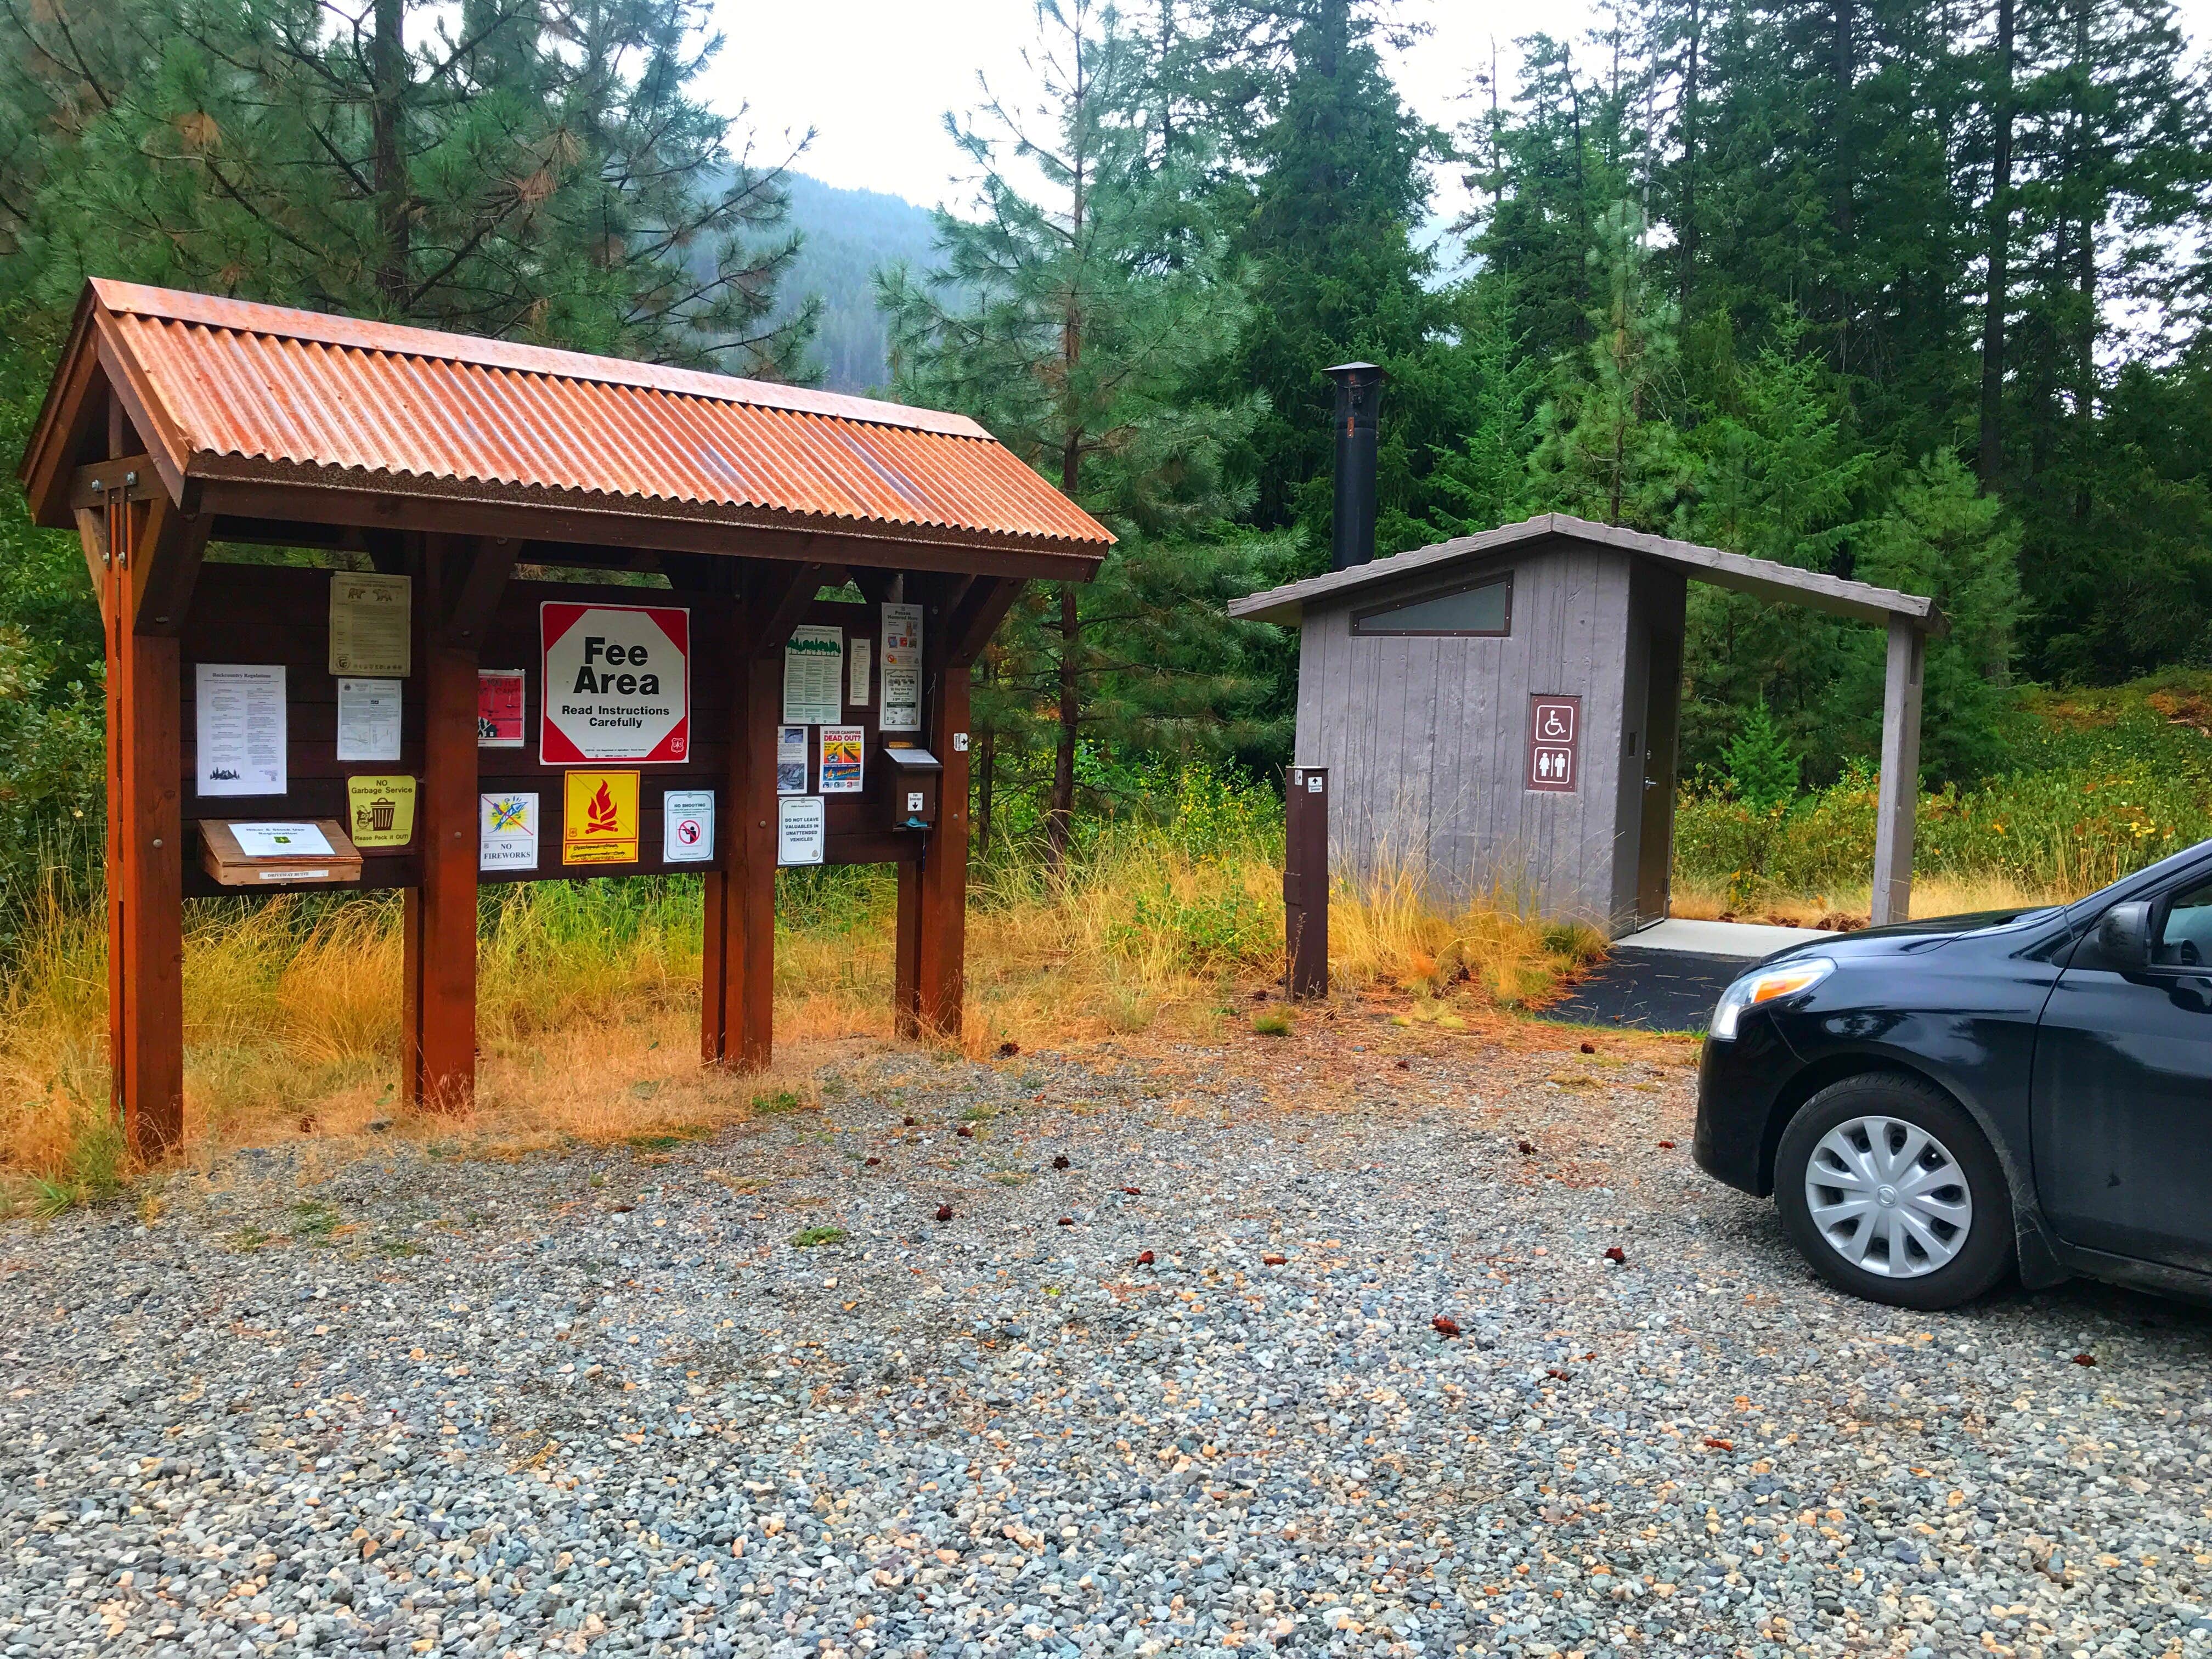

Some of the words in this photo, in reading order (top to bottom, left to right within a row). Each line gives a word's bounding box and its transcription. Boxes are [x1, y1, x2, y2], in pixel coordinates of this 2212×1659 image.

[585, 637, 648, 666] Fee
[573, 666, 659, 695] Area
[562, 706, 592, 715] Read
[599, 706, 669, 715] Instructions
[589, 718, 642, 728] Carefully
[484, 851, 531, 860] FIREWORKS
